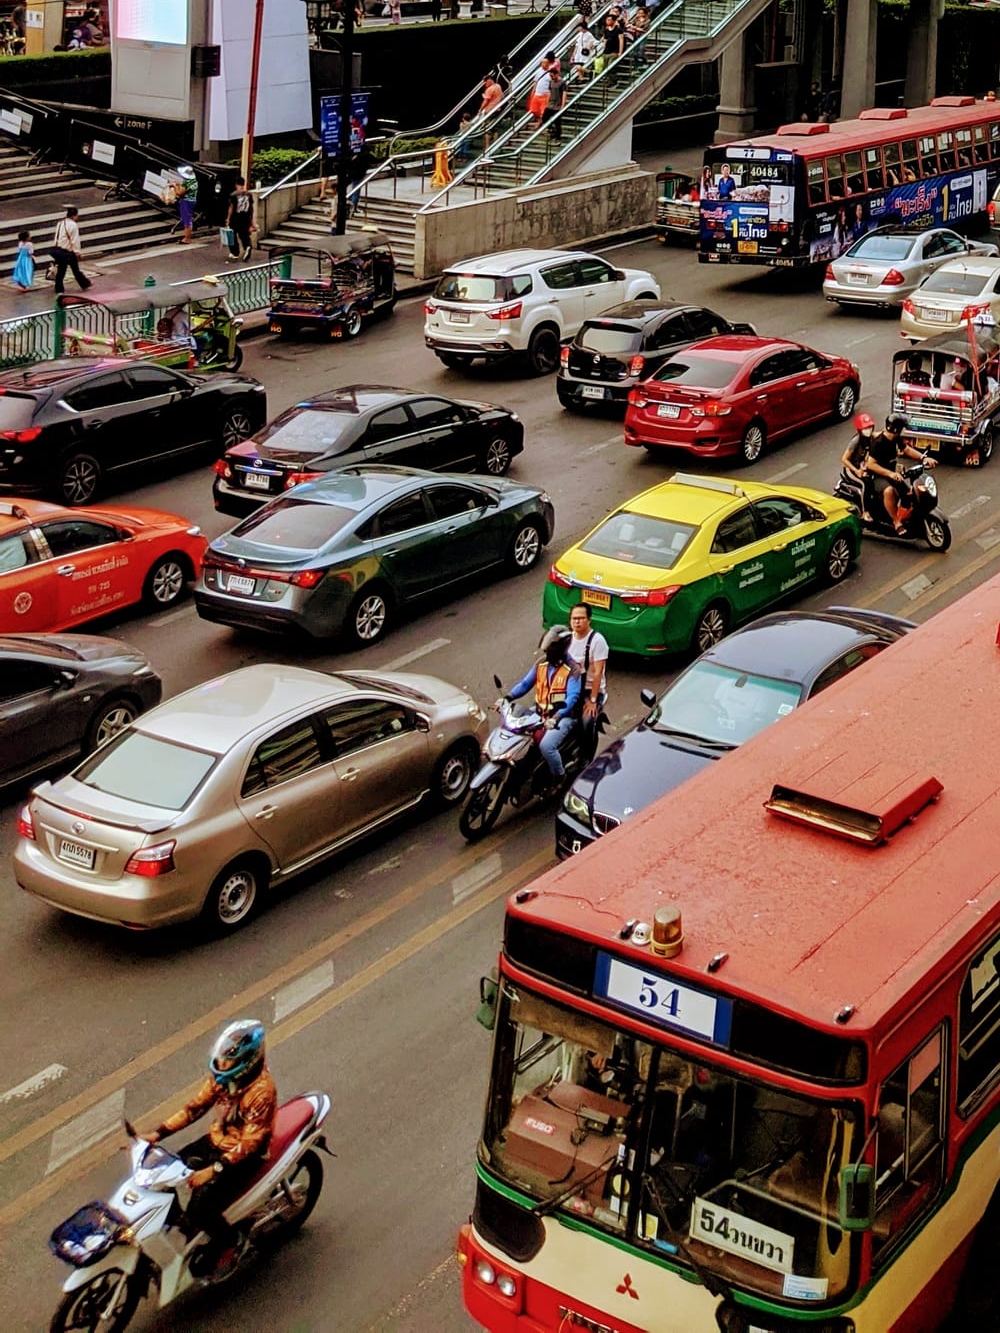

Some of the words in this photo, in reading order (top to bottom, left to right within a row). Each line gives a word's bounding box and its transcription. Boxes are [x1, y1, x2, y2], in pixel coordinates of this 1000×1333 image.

[127, 119, 146, 130] zone
[147, 121, 153, 130] F
[744, 149, 756, 158] 77
[750, 167, 779, 177] 40484
[731, 218, 738, 238] 1
[638, 976, 682, 1020] 54
